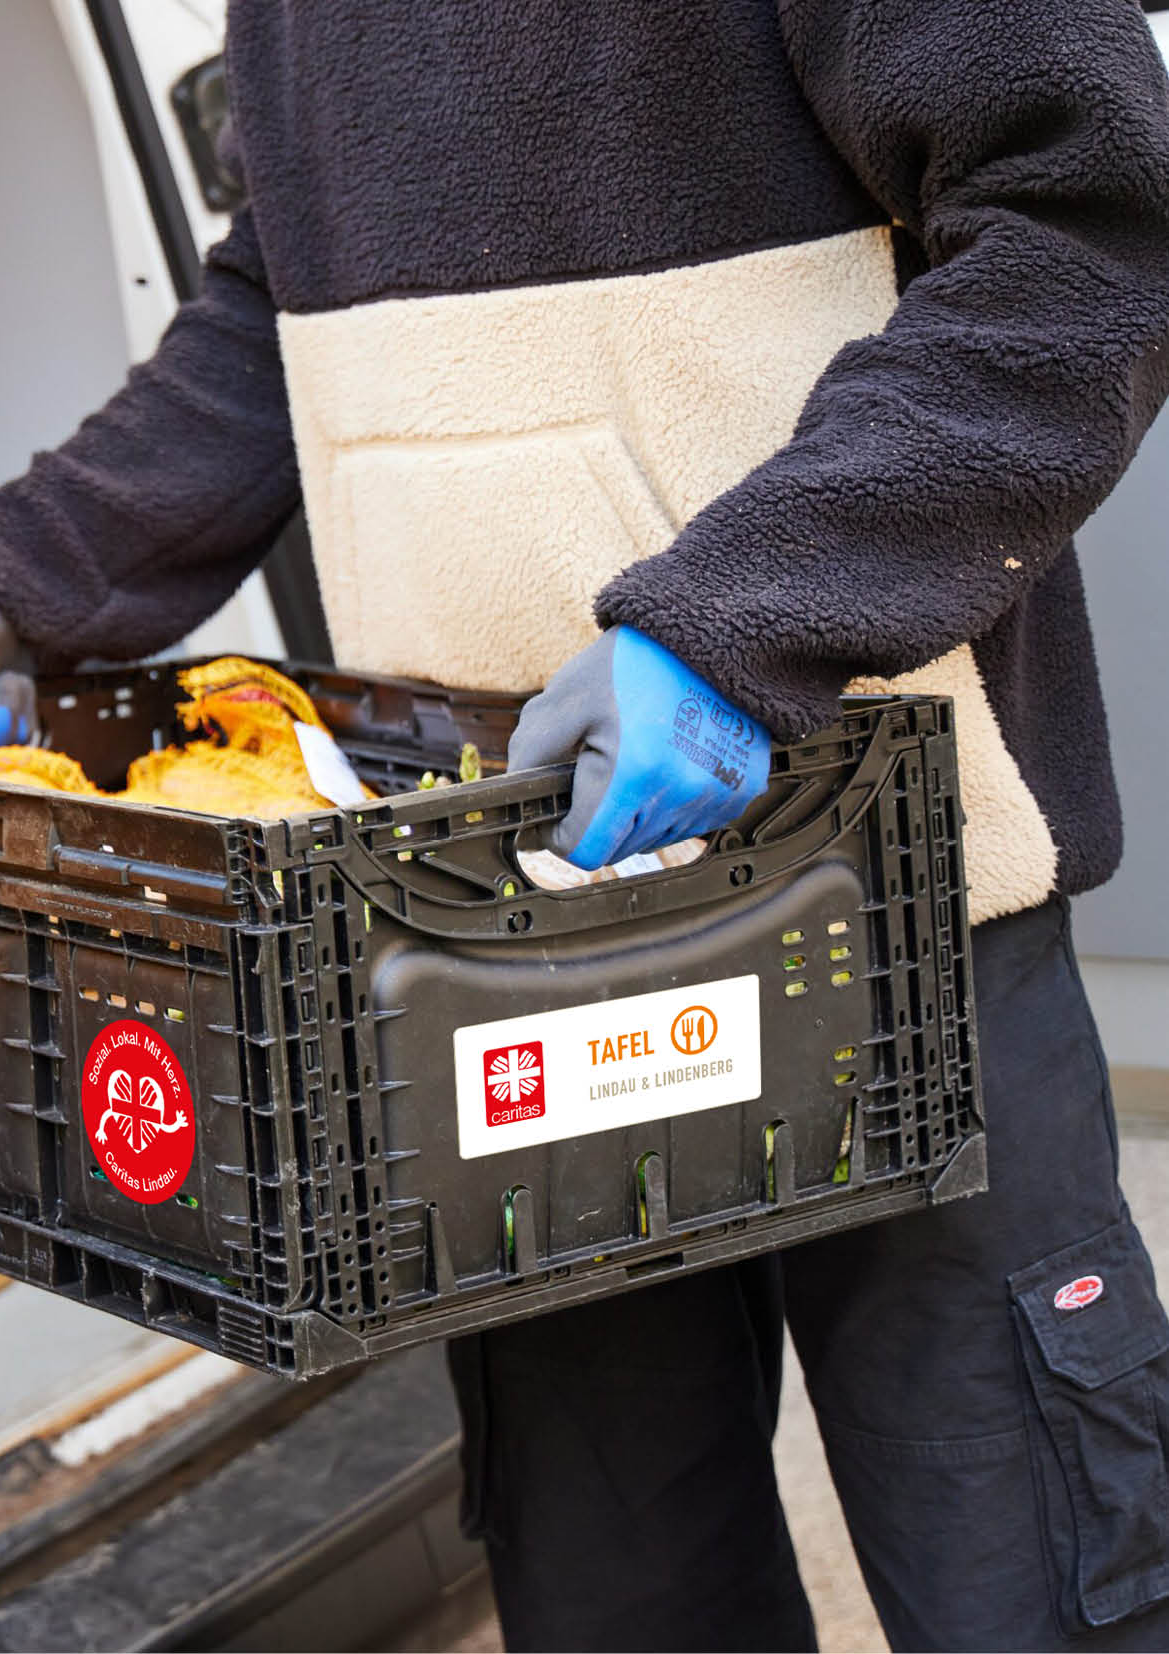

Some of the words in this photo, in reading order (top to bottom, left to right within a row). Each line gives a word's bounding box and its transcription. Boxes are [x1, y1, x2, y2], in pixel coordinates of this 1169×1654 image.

[89, 1043, 112, 1085] Sozial.
[111, 1031, 141, 1049] Lokal.
[144, 1036, 162, 1060] Mit
[160, 1056, 181, 1099] Herz.
[588, 1030, 655, 1066] TAFEL
[590, 1077, 636, 1100] LINDAU
[642, 1077, 650, 1090] &
[655, 1058, 733, 1088] LINDENBERG
[491, 1103, 541, 1124] caritas
[105, 1151, 140, 1189] Caritas
[142, 1168, 178, 1192] Lindau.
